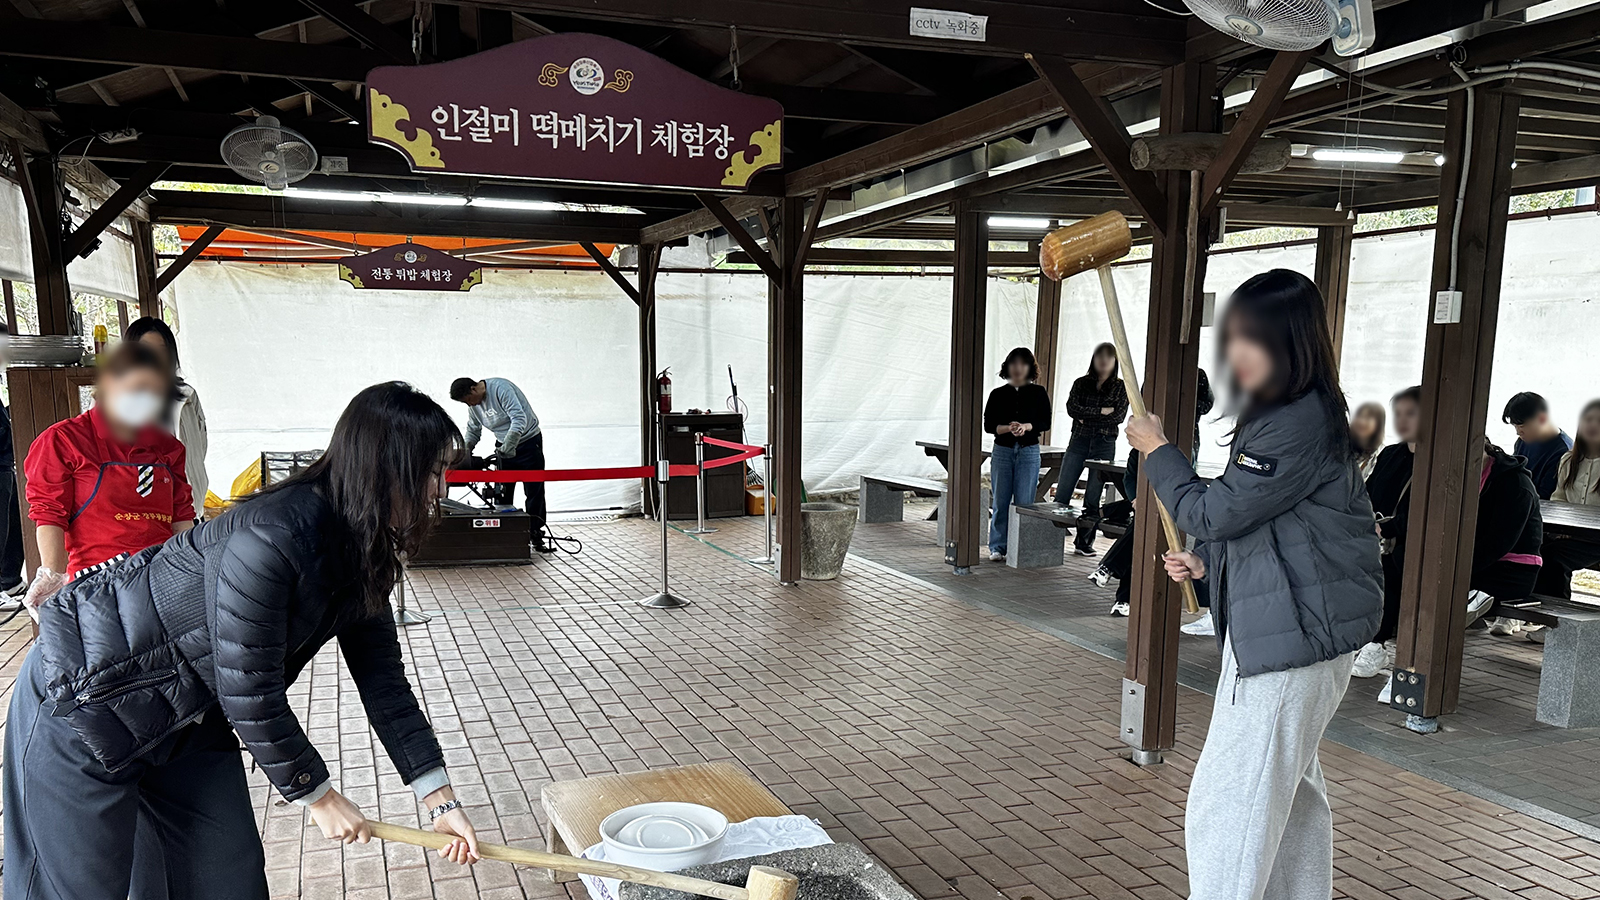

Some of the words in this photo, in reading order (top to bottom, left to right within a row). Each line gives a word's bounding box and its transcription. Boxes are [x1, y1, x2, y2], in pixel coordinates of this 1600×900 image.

[916, 18, 940, 29] cctv
[946, 19, 980, 35] 녹화중
[431, 103, 519, 146] 인절미
[530, 110, 643, 155] 떡메치기
[650, 119, 735, 160] 체험장
[370, 267, 393, 281] 전통
[395, 268, 418, 282] 튀밥
[419, 269, 453, 282] 체험장
